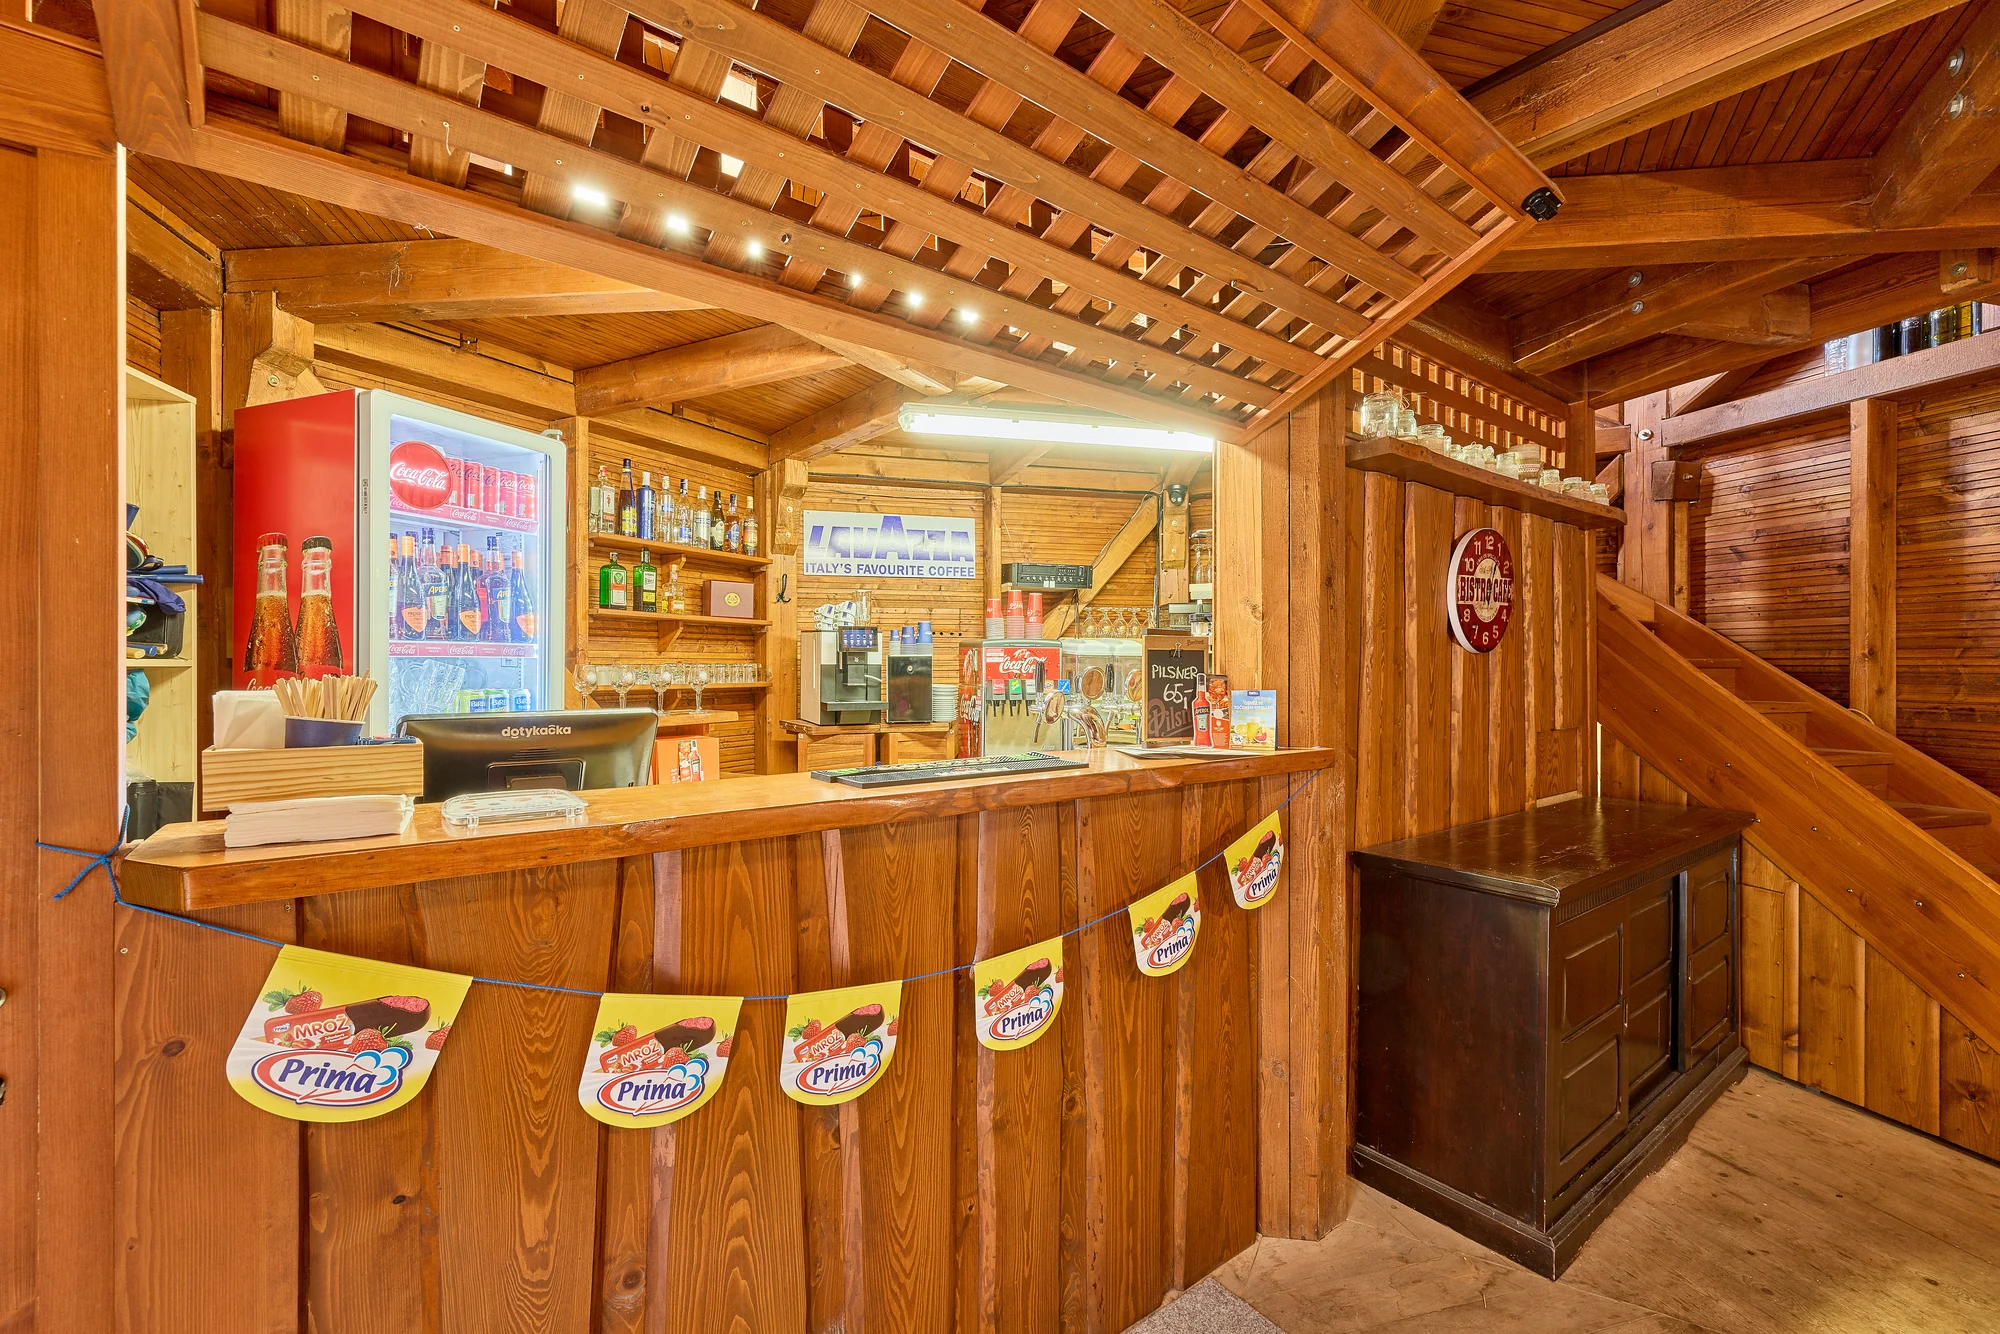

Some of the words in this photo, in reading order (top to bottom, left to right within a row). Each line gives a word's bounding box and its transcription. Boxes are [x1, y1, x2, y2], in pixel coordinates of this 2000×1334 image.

[390, 462, 448, 490] Coca-Cola
[1474, 540, 1481, 556] 11
[1485, 535, 1494, 550] 12
[1497, 542, 1502, 557] 1
[805, 563, 852, 574] ITALY'S
[856, 564, 924, 576] FAVOURITE
[928, 566, 975, 577] COFFEE
[1465, 557, 1475, 572] 10
[1503, 562, 1510, 575] 2
[1460, 575, 1492, 603] BISTRO
[1463, 608, 1471, 623] 8
[1501, 608, 1507, 622] 4
[1472, 625, 1479, 640] 7
[1482, 631, 1489, 645] 6
[1492, 625, 1499, 639] 5
[1151, 664, 1198, 679] PILSNER
[1251, 868, 1277, 896] Prima
[1156, 936, 1188, 962] Prima
[293, 1015, 351, 1040] MROŽ
[1002, 1007, 1043, 1033] Prima
[621, 1038, 660, 1067] MROŽ
[278, 1059, 378, 1094] Prima
[812, 1062, 867, 1086] Prima
[617, 1080, 686, 1102] Prima
